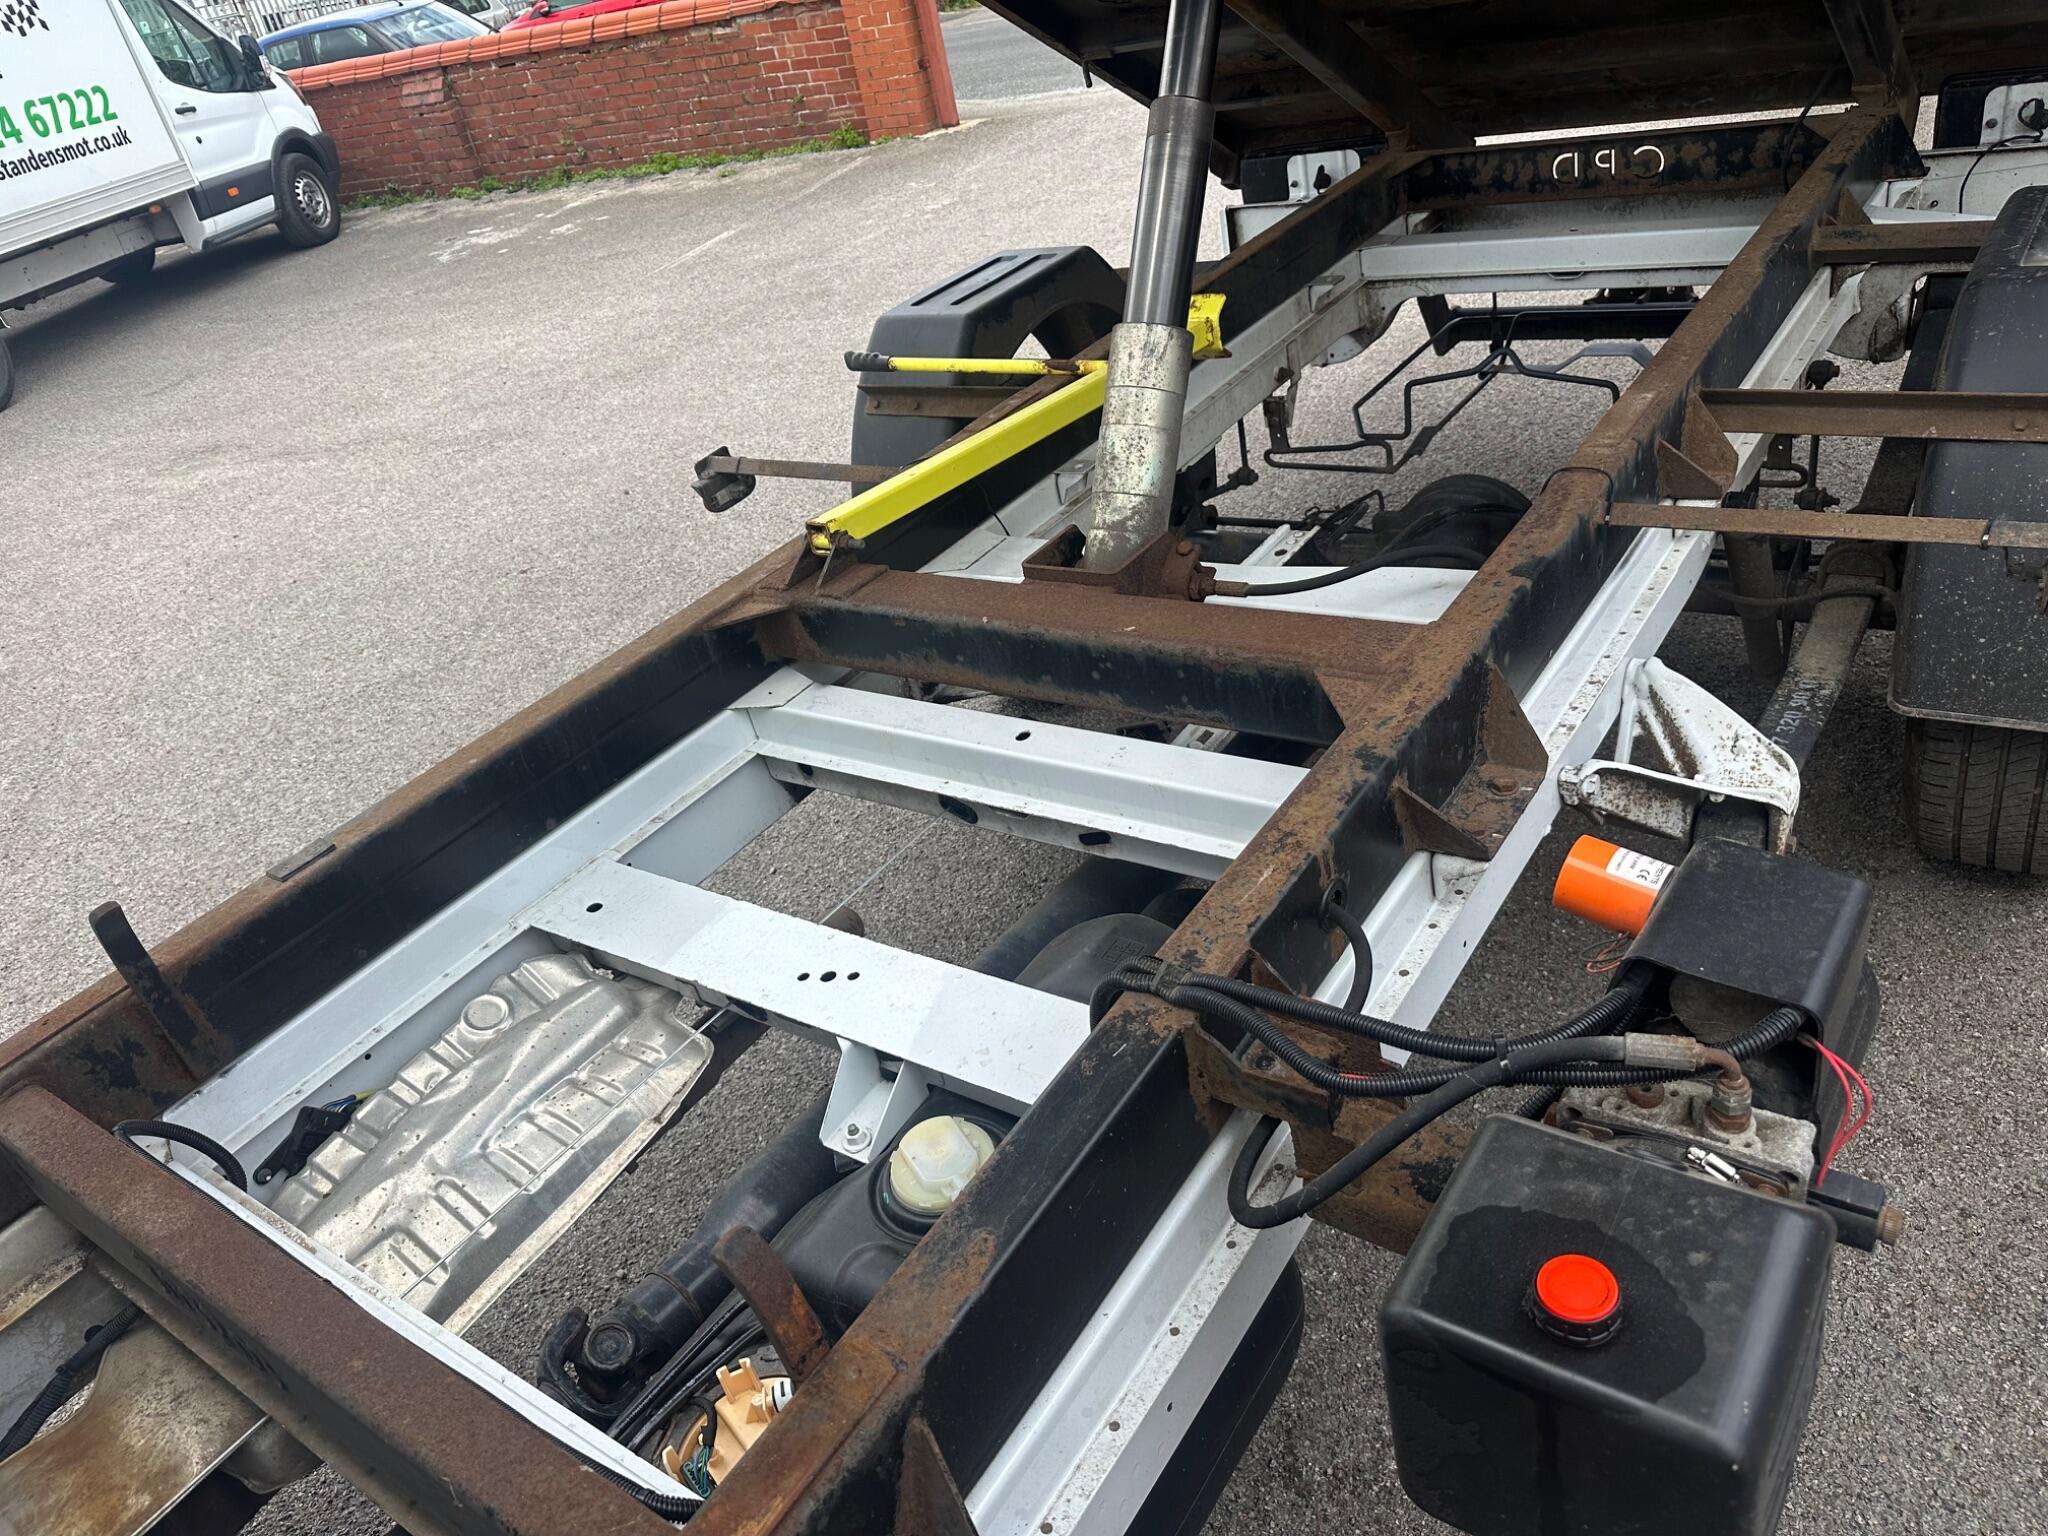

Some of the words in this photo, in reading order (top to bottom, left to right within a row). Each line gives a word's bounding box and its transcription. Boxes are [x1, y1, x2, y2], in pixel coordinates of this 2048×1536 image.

[0, 106, 23, 148] 4
[24, 85, 118, 138] 67222
[0, 126, 132, 181] standensmot.co.uk
